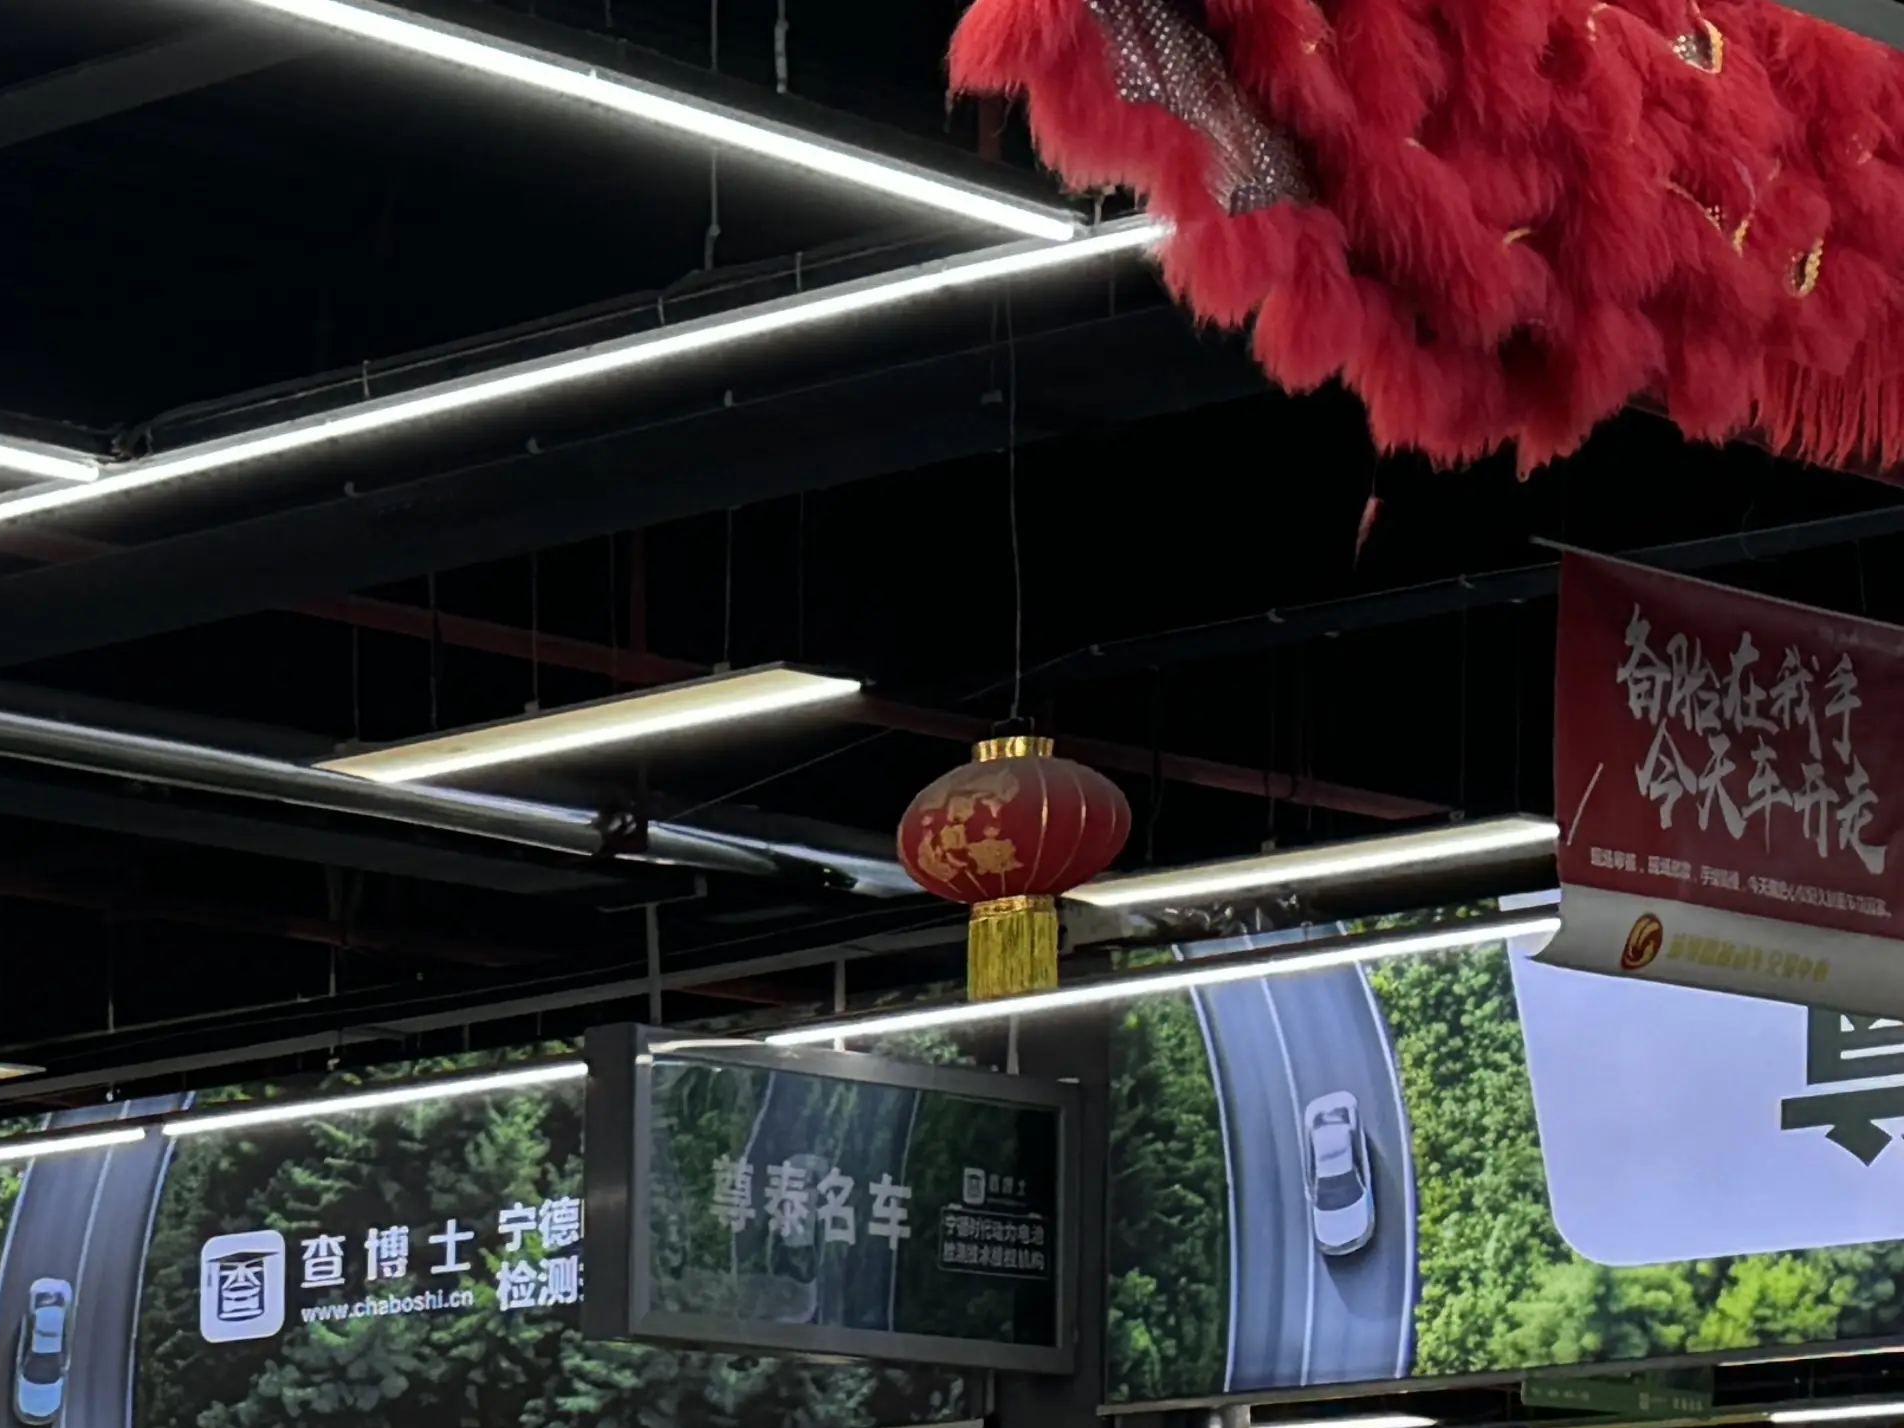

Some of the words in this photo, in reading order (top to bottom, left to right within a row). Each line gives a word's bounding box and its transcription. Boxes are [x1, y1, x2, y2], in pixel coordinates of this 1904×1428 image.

[711, 1153, 913, 1250] 尊泰名车
[300, 1218, 475, 1289] 查博士
[498, 1196, 584, 1252] 宁德
[301, 1288, 474, 1323] www.chaboshi.cn
[496, 1254, 584, 1312] 检测
